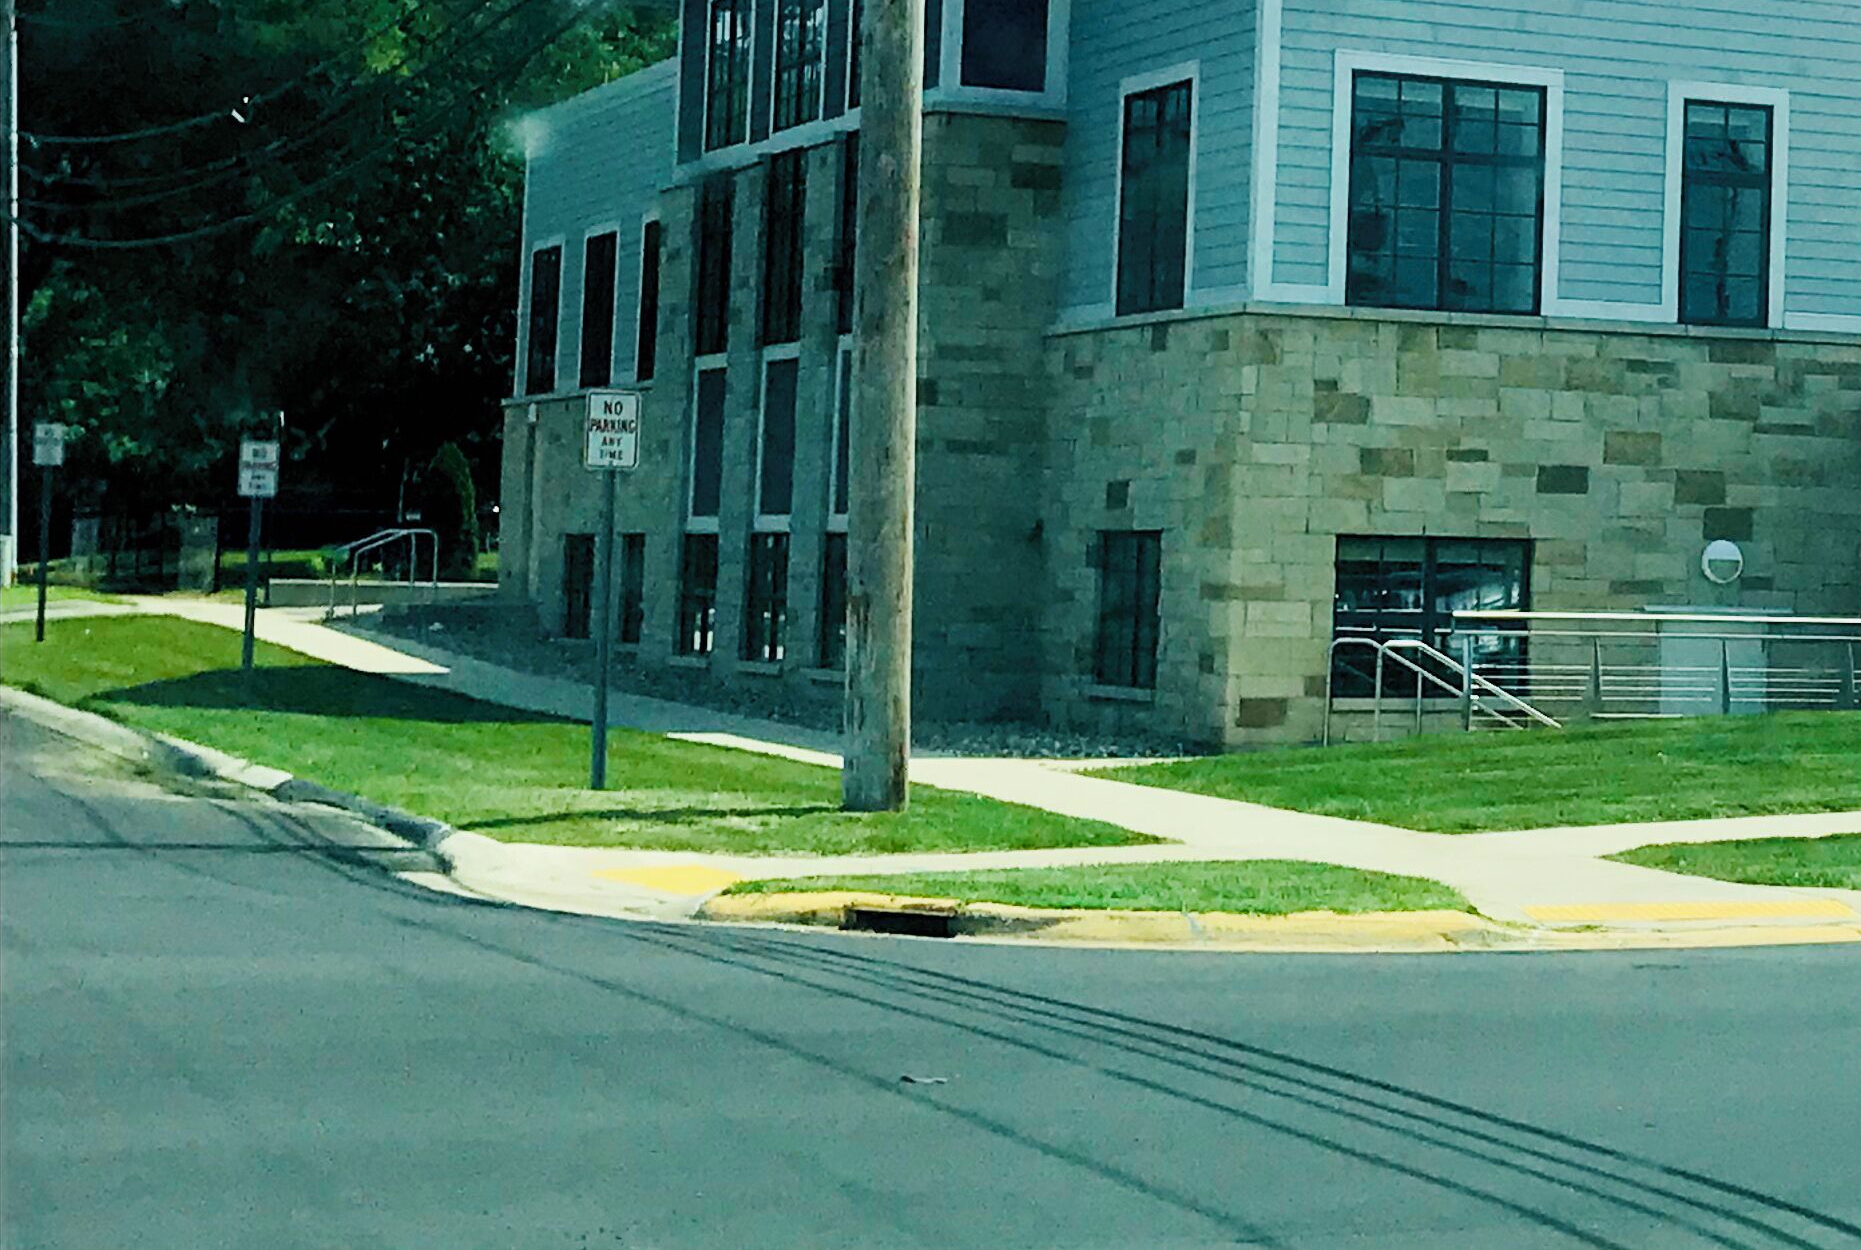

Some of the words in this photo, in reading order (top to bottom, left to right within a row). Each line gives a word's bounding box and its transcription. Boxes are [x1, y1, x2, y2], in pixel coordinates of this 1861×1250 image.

[604, 400, 624, 416] NO
[589, 419, 637, 434] PARKING
[602, 436, 623, 447] ANY
[600, 449, 623, 460] TIME
